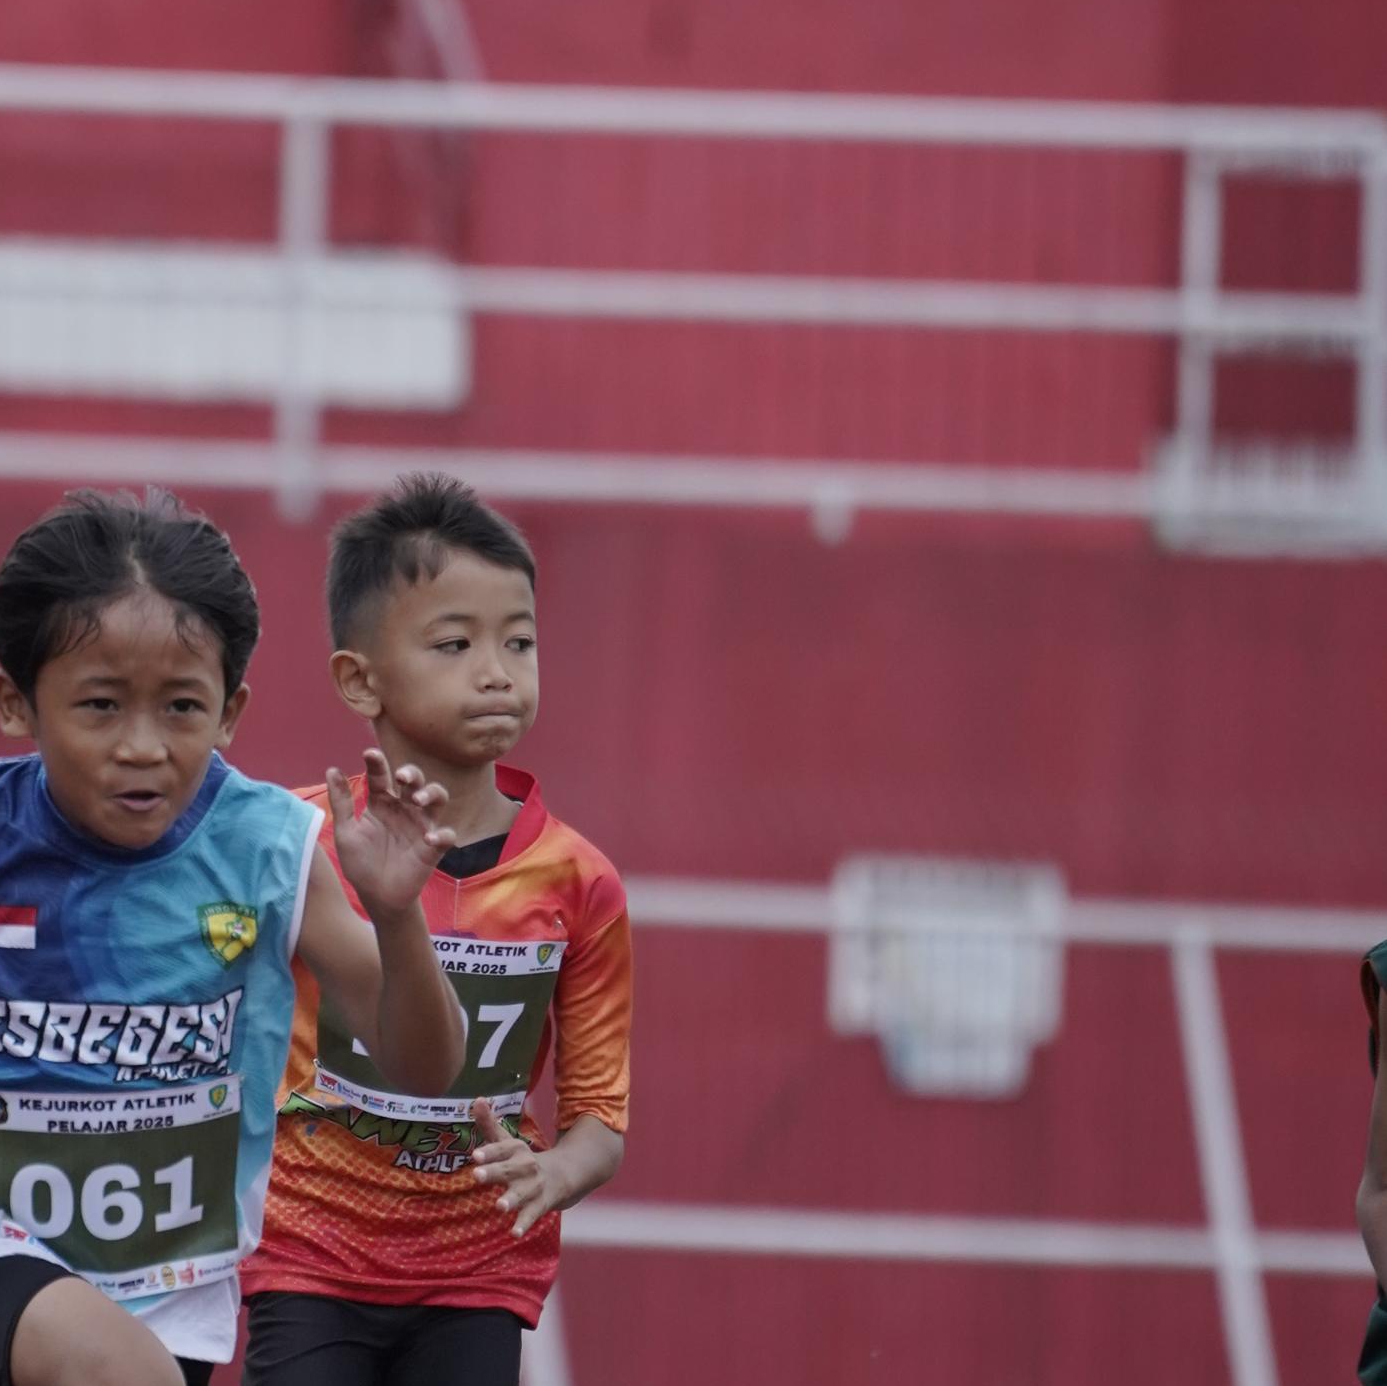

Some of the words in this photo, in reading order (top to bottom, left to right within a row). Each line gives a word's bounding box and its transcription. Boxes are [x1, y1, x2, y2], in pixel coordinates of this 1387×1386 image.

[465, 944, 528, 957] ATLETIK
[471, 963, 507, 974] 2025
[19, 1097, 116, 1113] KEJURKOT
[123, 1092, 196, 1111] ATLETIK
[47, 1119, 128, 1133] PELAJAR
[133, 1116, 174, 1129] 2025
[10, 1155, 204, 1241] 061
